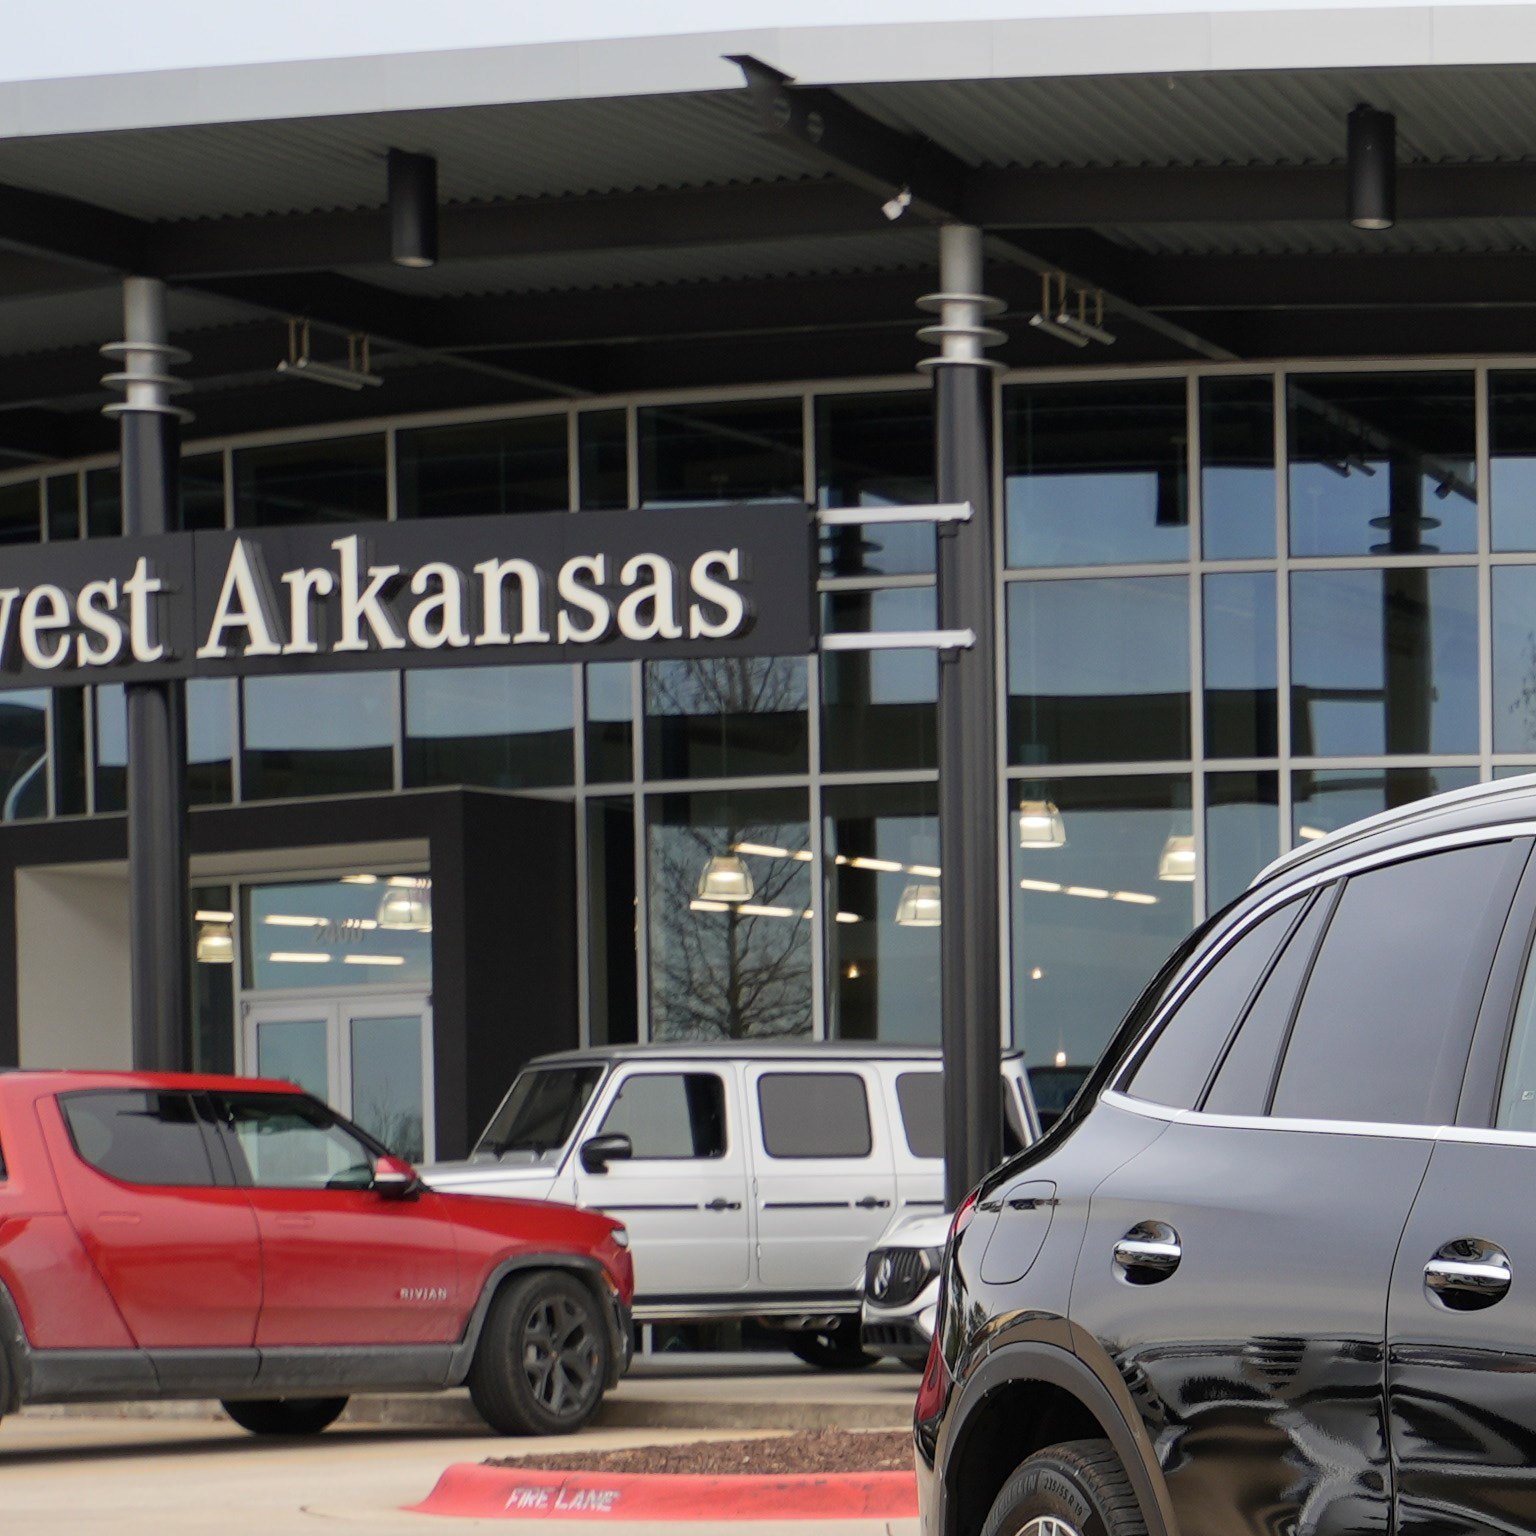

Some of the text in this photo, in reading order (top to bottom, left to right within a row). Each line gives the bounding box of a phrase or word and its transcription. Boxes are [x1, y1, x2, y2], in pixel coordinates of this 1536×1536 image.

[197, 536, 744, 657] Arkansas
[400, 1286, 447, 1301] RIVIAN
[504, 1485, 620, 1513] FIRE LANE
